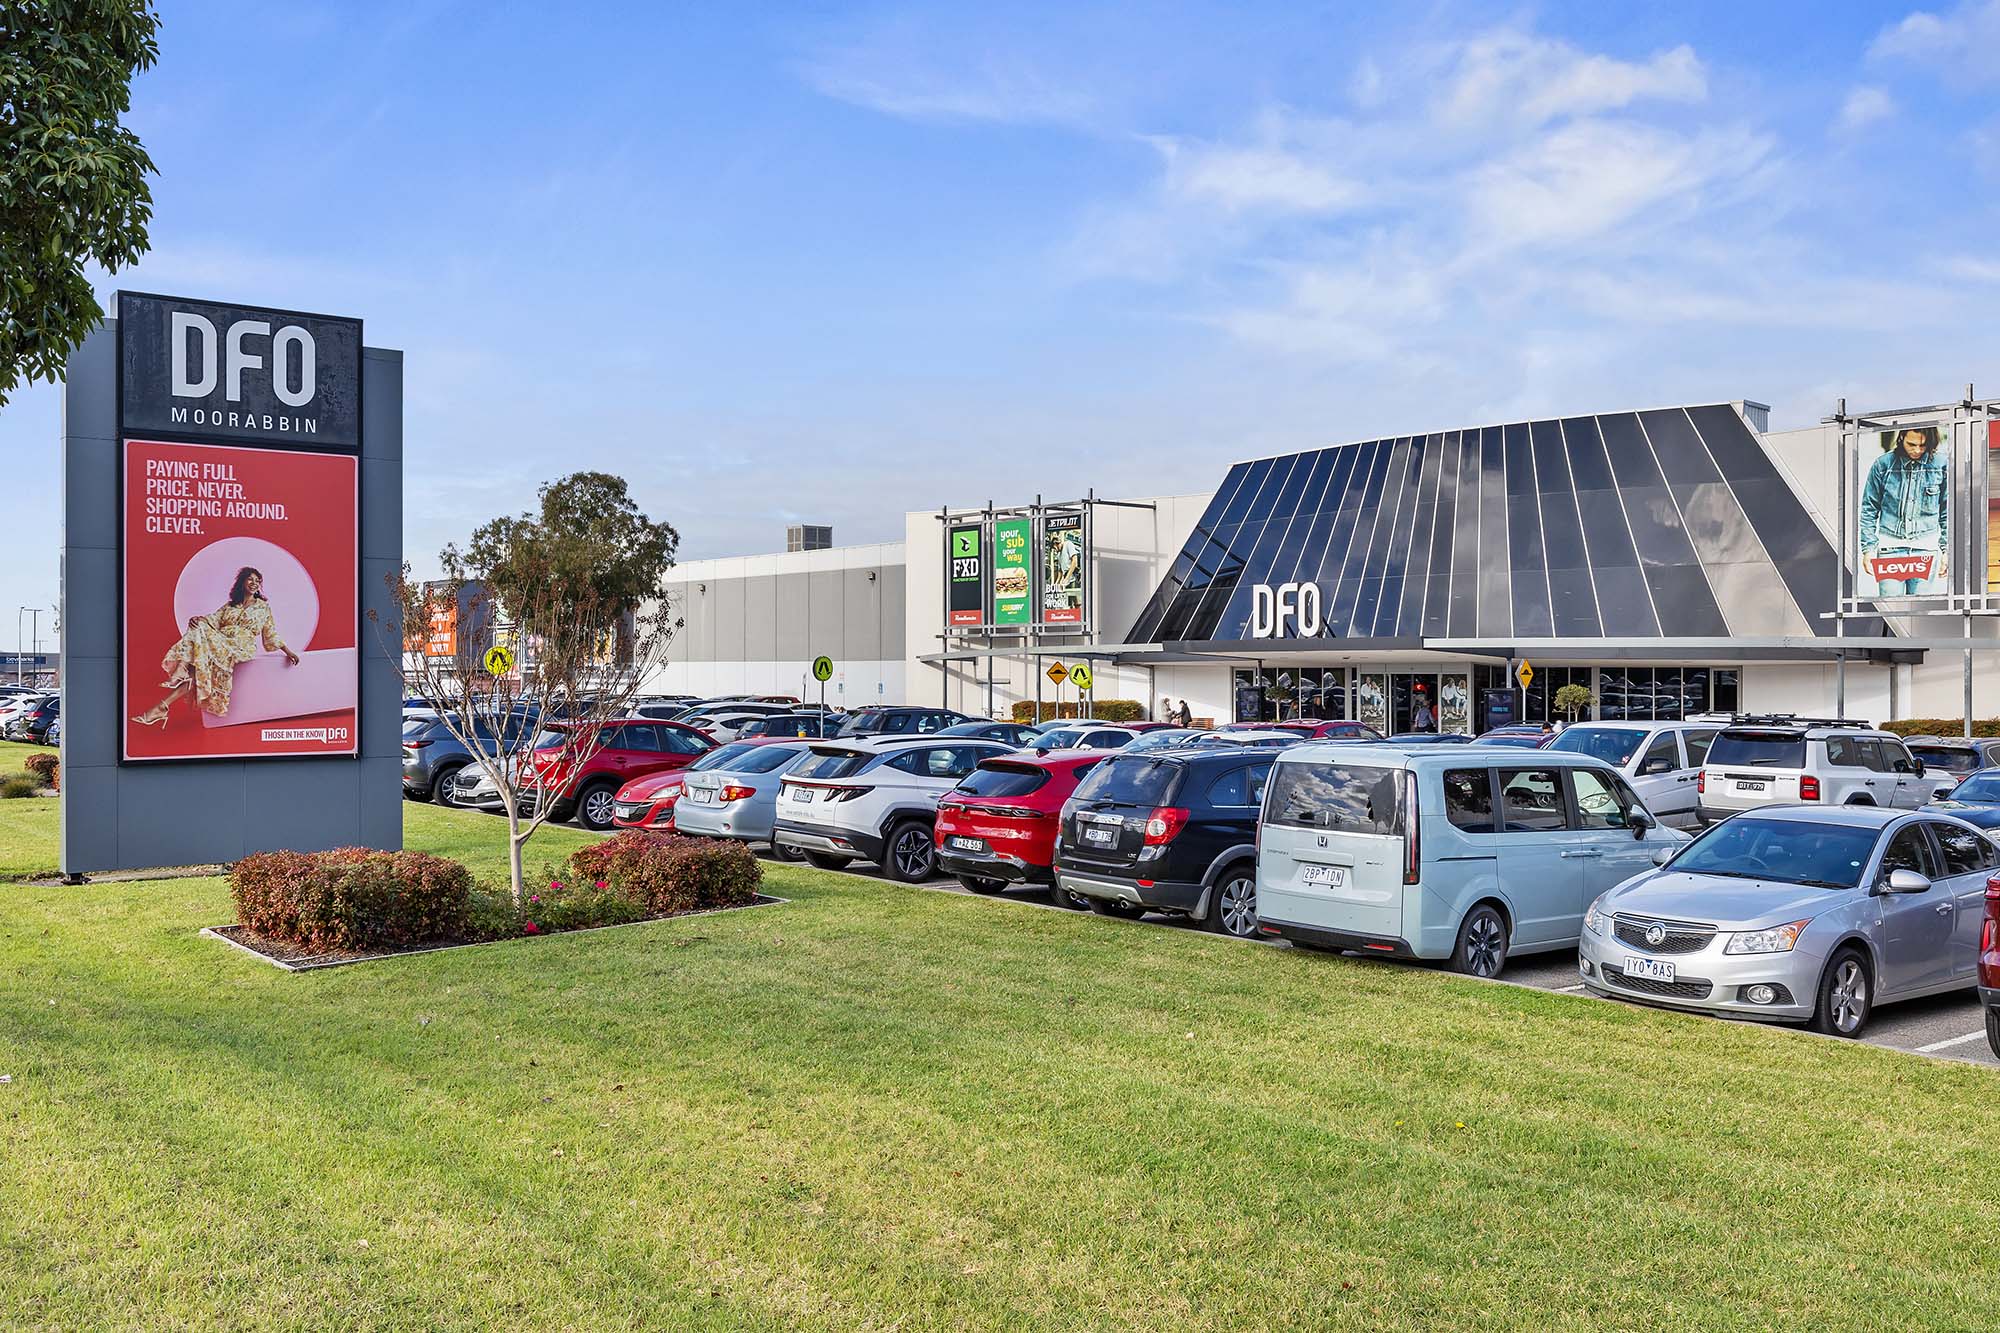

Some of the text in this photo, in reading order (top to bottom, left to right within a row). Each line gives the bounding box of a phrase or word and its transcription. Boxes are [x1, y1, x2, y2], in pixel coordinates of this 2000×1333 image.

[172, 312, 315, 407] DFO
[172, 407, 317, 434] MOORABBIN
[146, 459, 237, 481] PAYING FULL
[146, 479, 247, 500] PRICE. NEVER.
[146, 497, 288, 520] SHOPPING AROUND.
[146, 516, 204, 535] CLEVER.
[1000, 530, 1019, 542] your
[1006, 534, 1025, 549] sub
[1002, 548, 1017, 558] your
[1006, 553, 1023, 563] way
[1252, 582, 1320, 638] DFO
[264, 729, 325, 739] THOSE IN THE KNOW
[328, 728, 347, 740] DFO
